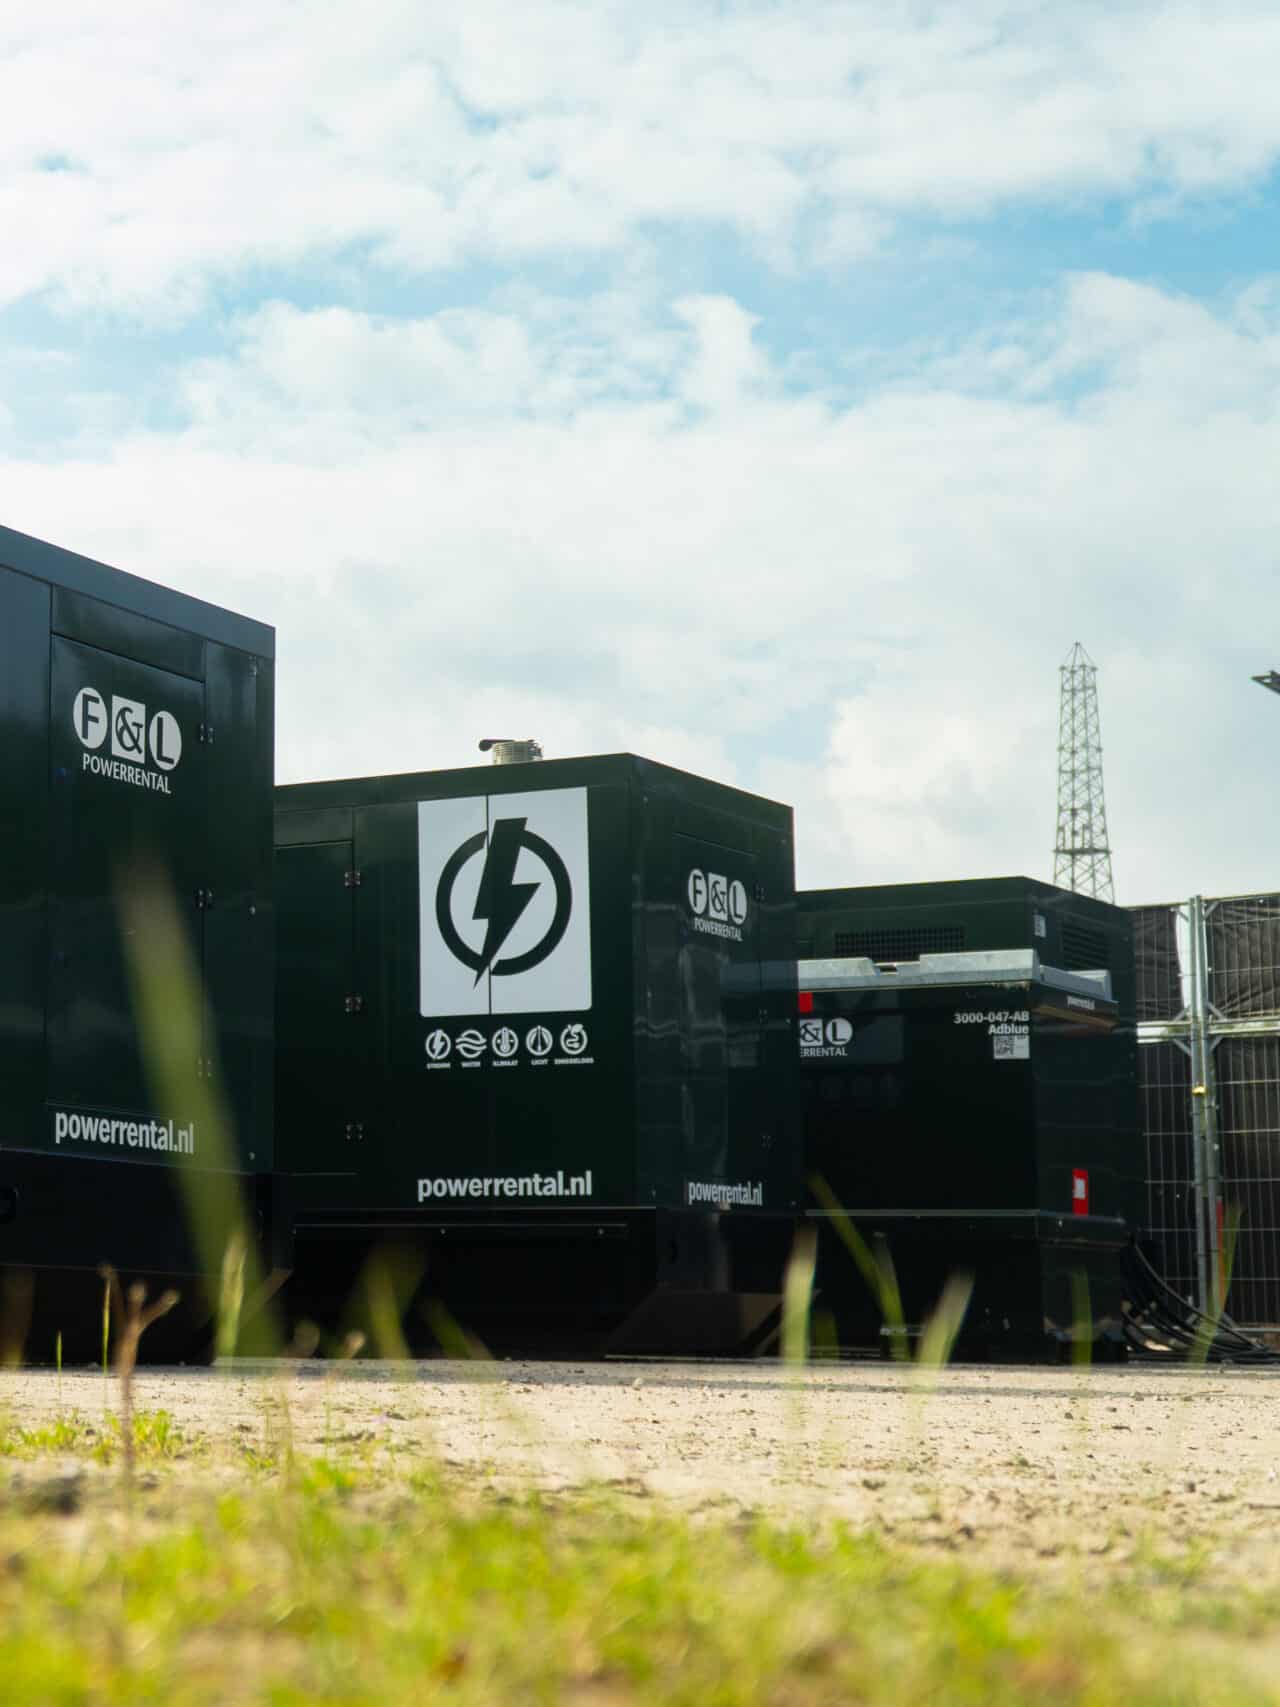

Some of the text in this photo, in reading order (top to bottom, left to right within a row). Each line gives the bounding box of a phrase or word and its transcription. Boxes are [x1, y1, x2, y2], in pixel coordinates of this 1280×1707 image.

[77, 690, 178, 768] F&L
[83, 752, 172, 794] POWERRENTAL
[690, 871, 746, 922] F&L
[694, 917, 743, 941] POWERRENTAL
[800, 1019, 851, 1045] &L
[800, 1047, 848, 1057] ERRENTAL
[55, 1111, 194, 1155] powerrental.nl
[418, 1170, 593, 1203] powerrental.nl
[688, 1181, 763, 1206] powerrental.nl
